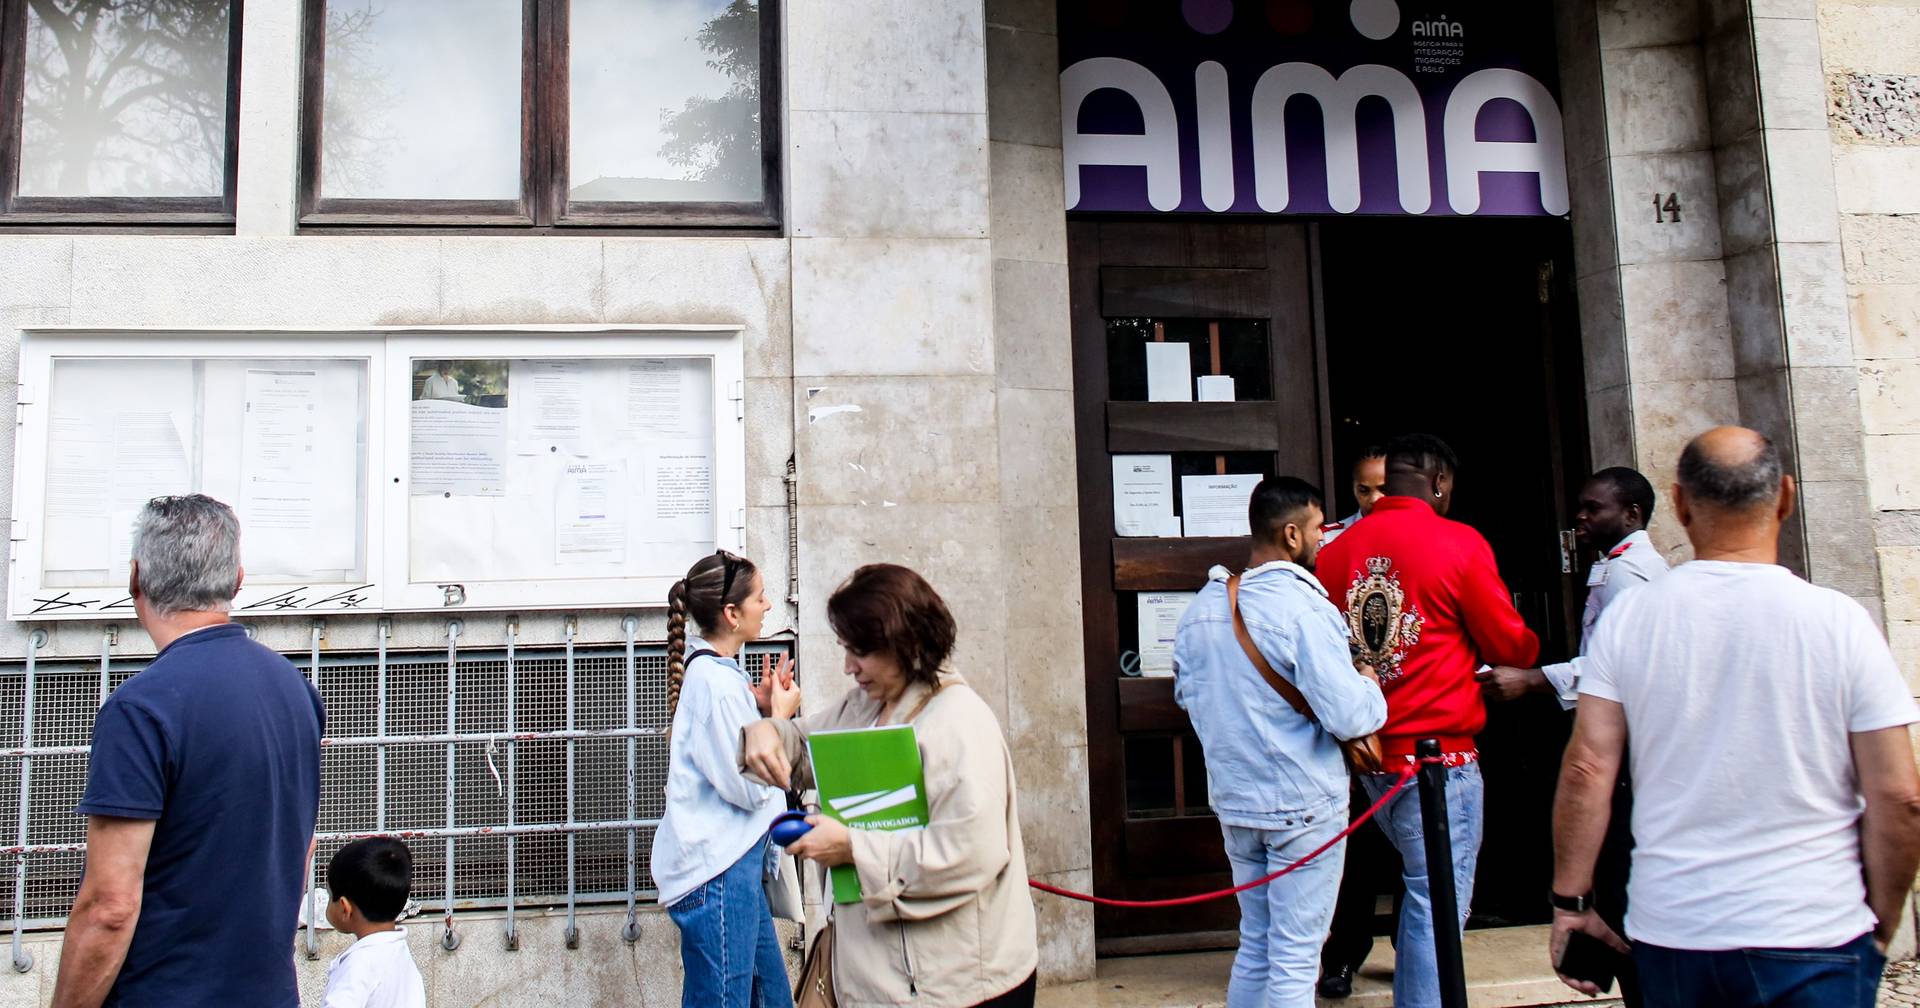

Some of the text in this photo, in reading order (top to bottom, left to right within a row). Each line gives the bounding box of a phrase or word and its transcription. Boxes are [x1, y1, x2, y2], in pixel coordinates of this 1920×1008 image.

[1412, 20, 1463, 38] AIMA
[1415, 65, 1421, 73] E
[1060, 56, 1571, 216] AIMA
[1652, 192, 1681, 224] 14
[866, 816, 919, 830] ADVOGADOS
